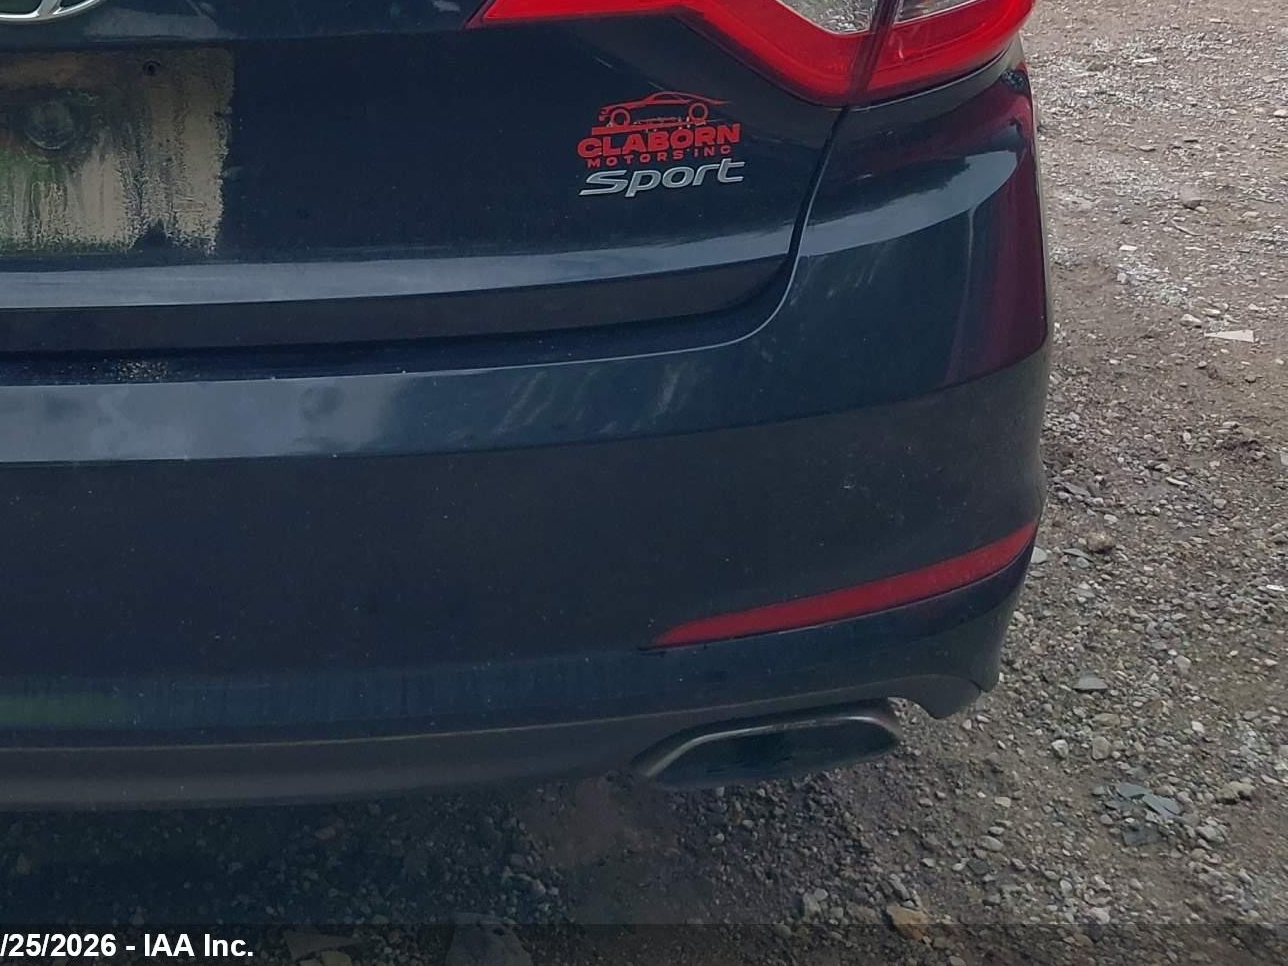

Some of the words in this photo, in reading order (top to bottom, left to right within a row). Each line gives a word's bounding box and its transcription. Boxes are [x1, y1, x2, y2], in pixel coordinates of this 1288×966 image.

[578, 123, 741, 158] CLABORN
[587, 150, 685, 168] MOTORS
[579, 158, 745, 198] Sport
